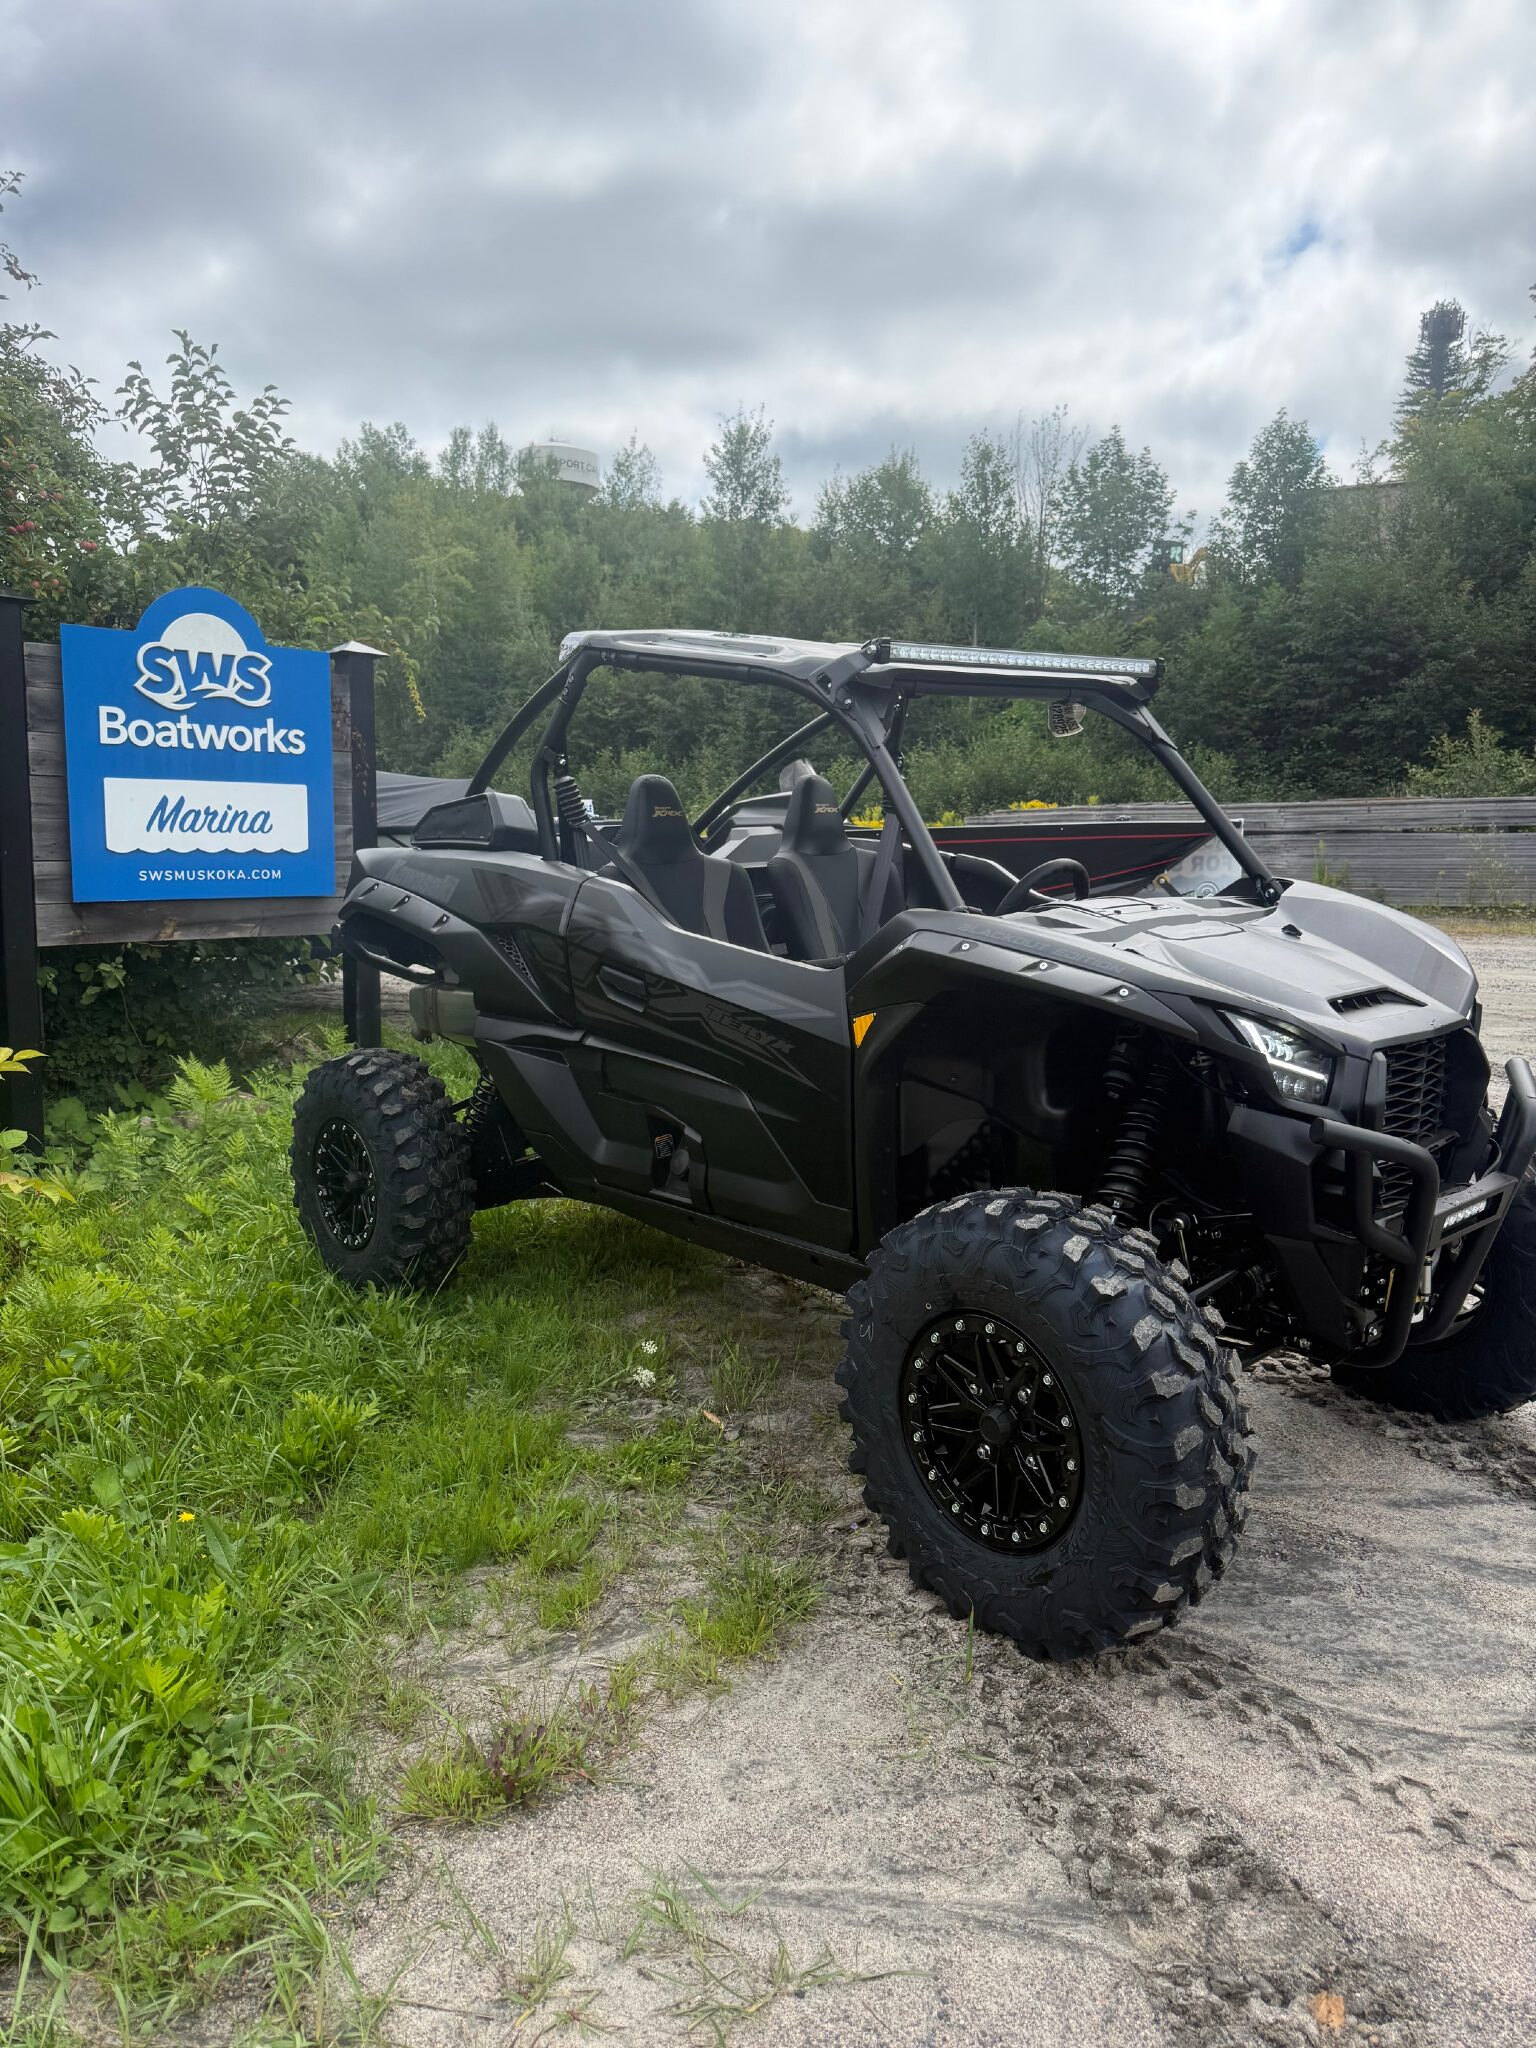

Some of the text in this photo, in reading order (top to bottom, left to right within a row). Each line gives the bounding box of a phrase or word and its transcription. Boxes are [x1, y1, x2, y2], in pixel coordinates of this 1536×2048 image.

[134, 643, 272, 708] SWS
[99, 705, 306, 755] Boatworks
[146, 795, 273, 835] Marina
[139, 868, 282, 882] SWSMUSKOKA.COM
[1053, 946, 1126, 974] EDITION
